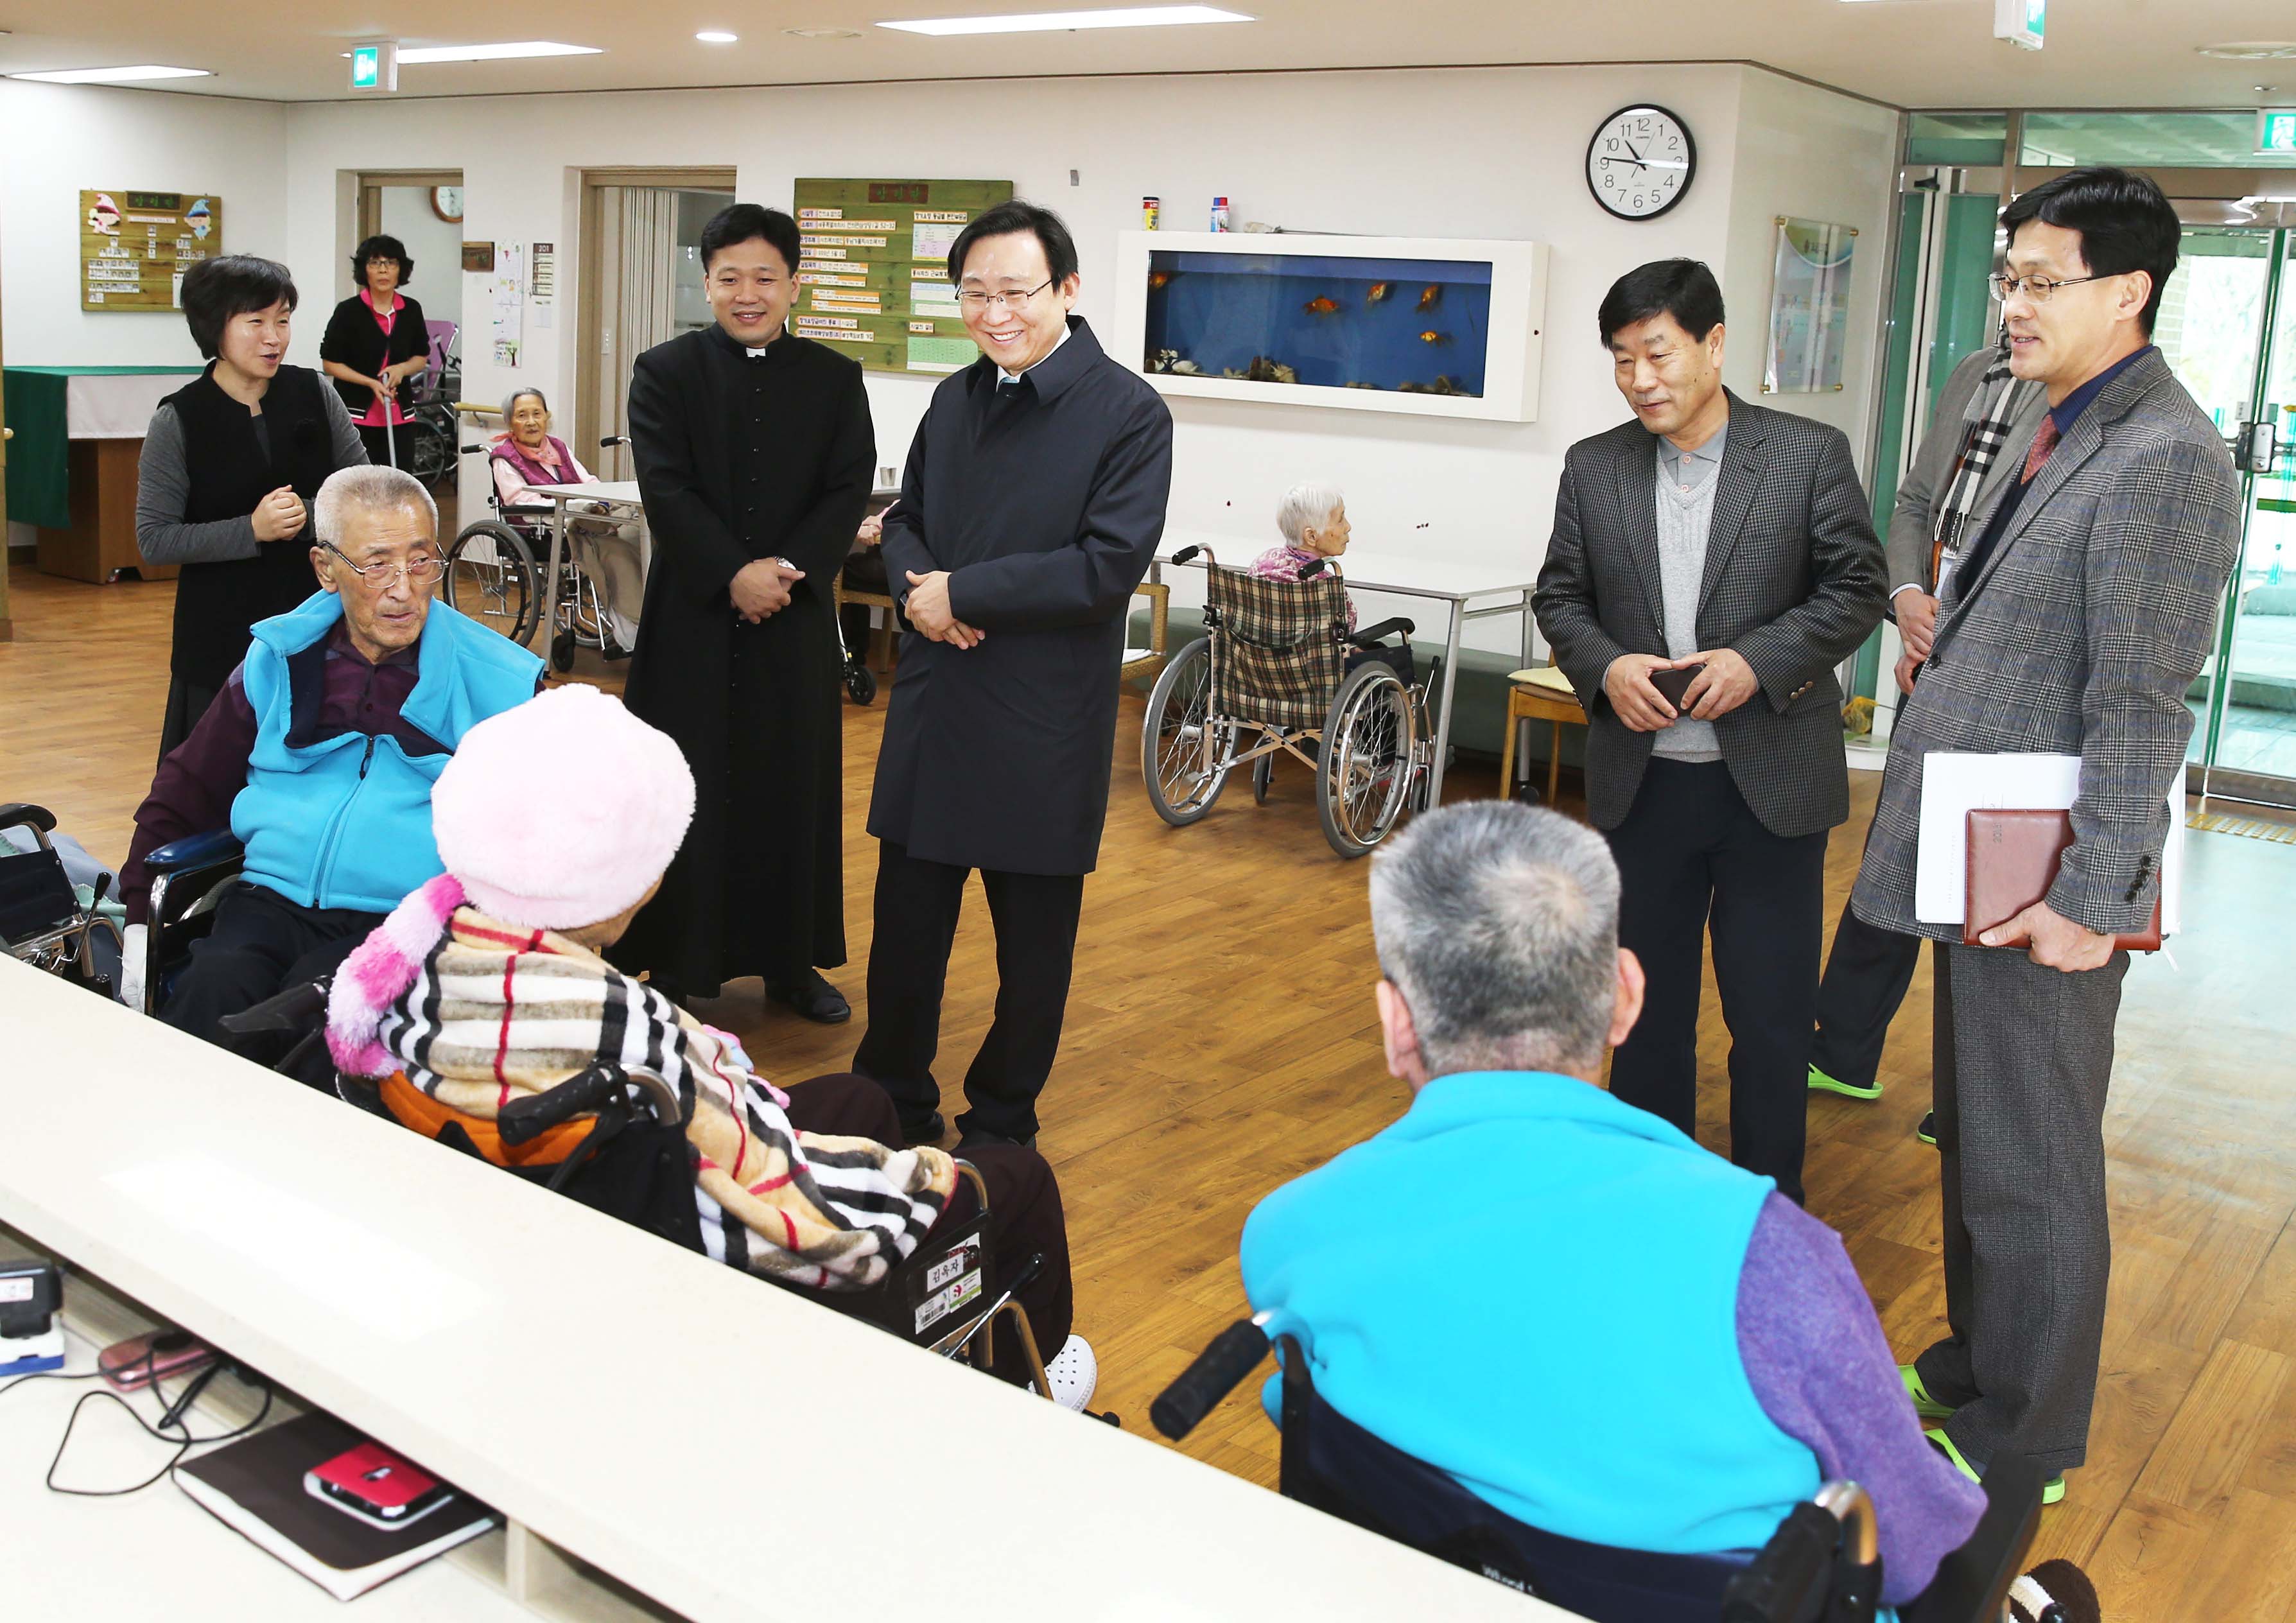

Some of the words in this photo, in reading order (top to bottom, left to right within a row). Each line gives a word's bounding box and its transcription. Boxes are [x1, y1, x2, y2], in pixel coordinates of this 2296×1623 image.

[1621, 124, 1631, 137] 11
[1637, 118, 1650, 132] 12
[1658, 124, 1664, 136] 1
[1606, 138, 1619, 152] 10
[1668, 137, 1678, 150] 2
[1600, 157, 1610, 170] 9
[1605, 175, 1614, 188] 8
[1664, 175, 1674, 189] 4
[1617, 189, 1627, 202] 7
[1633, 195, 1643, 208] 6
[1651, 190, 1660, 204] 5
[932, 1259, 959, 1283] 김옥자
